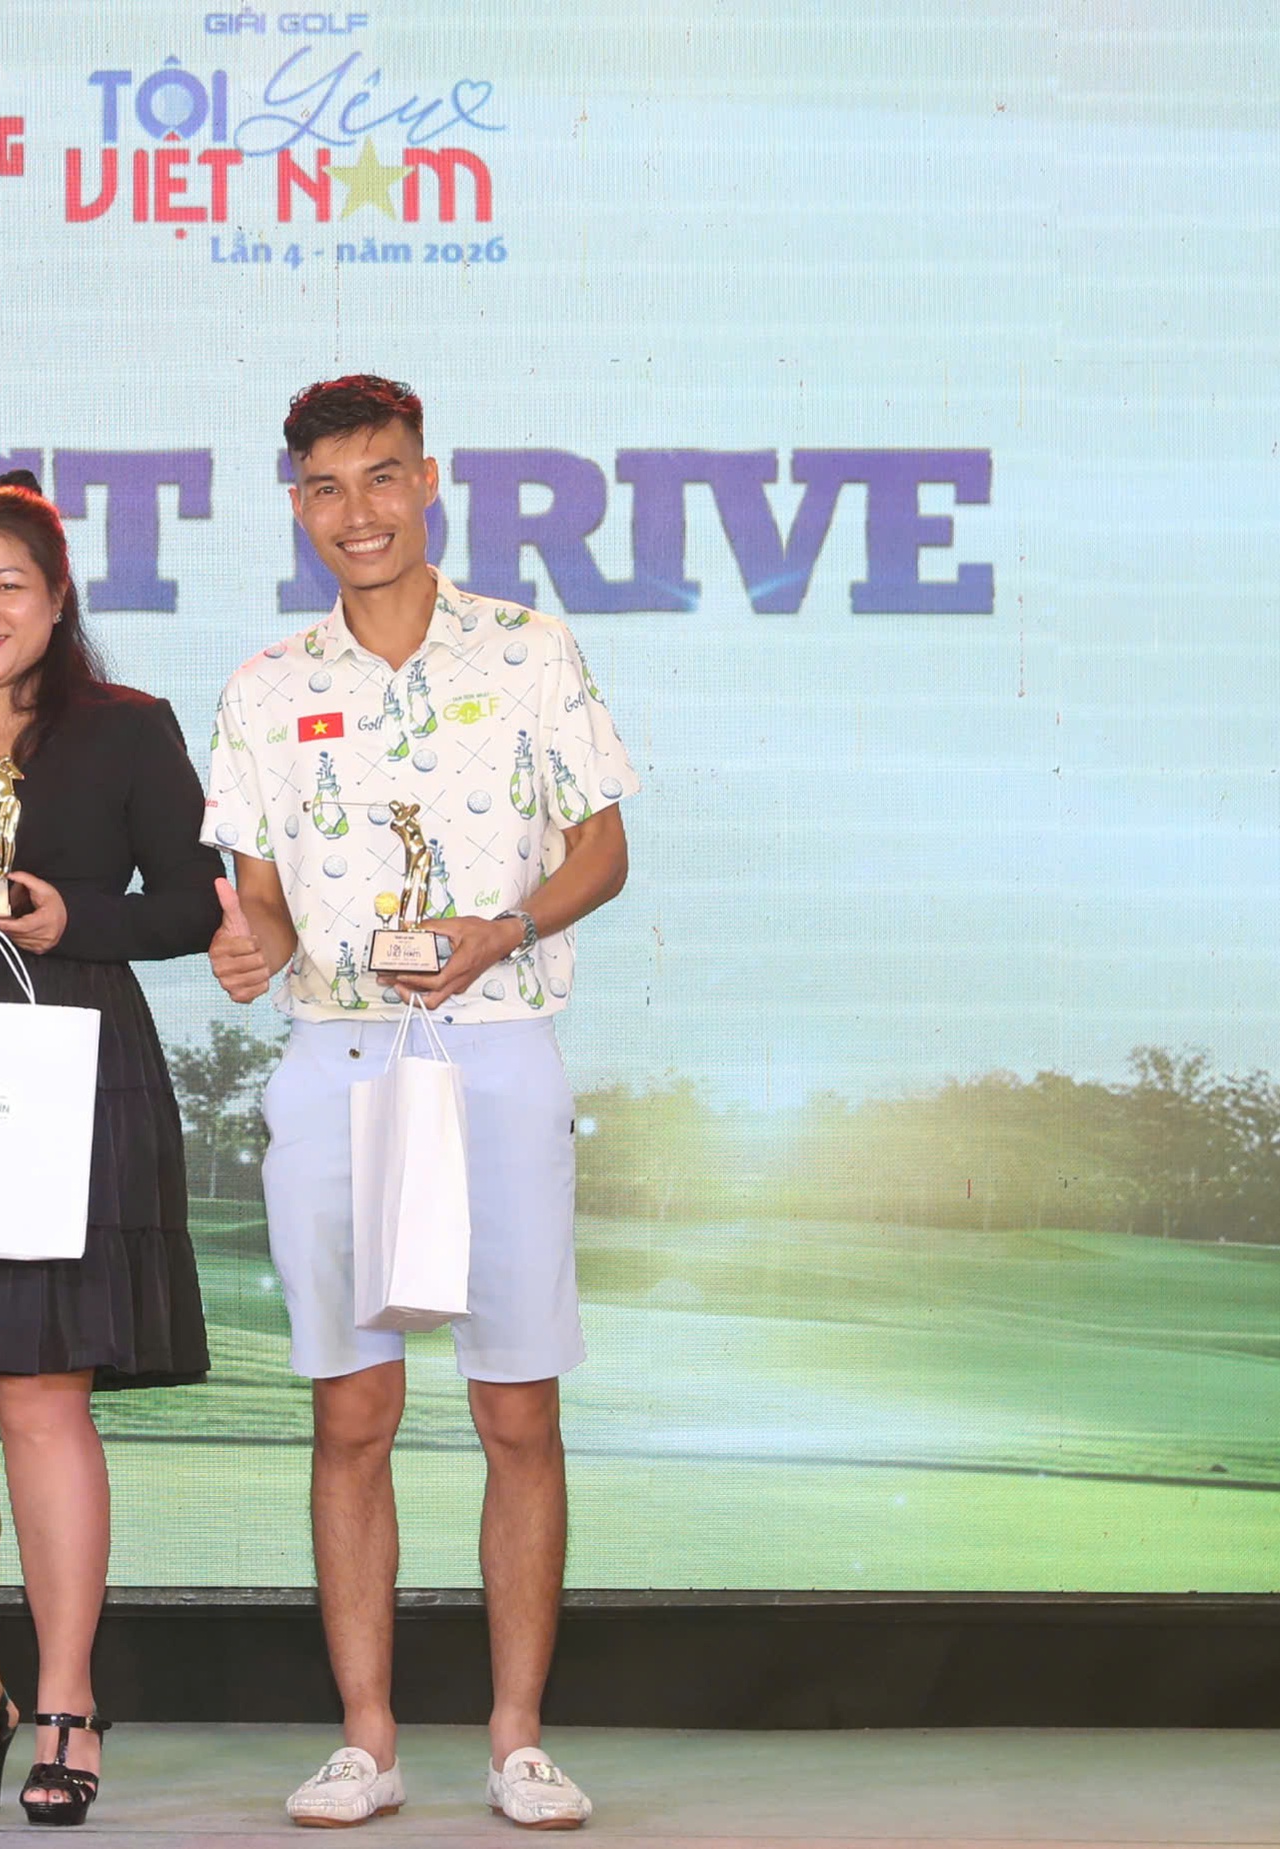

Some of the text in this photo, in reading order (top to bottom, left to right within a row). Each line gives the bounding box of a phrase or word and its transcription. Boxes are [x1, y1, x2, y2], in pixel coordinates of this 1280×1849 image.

[205, 6, 368, 34] GIẢI GOLF
[89, 45, 506, 157] TÔI Yêu
[65, 131, 244, 239] VIỆT
[283, 243, 304, 270] 4
[337, 236, 413, 264] năm
[422, 236, 507, 264] 2026
